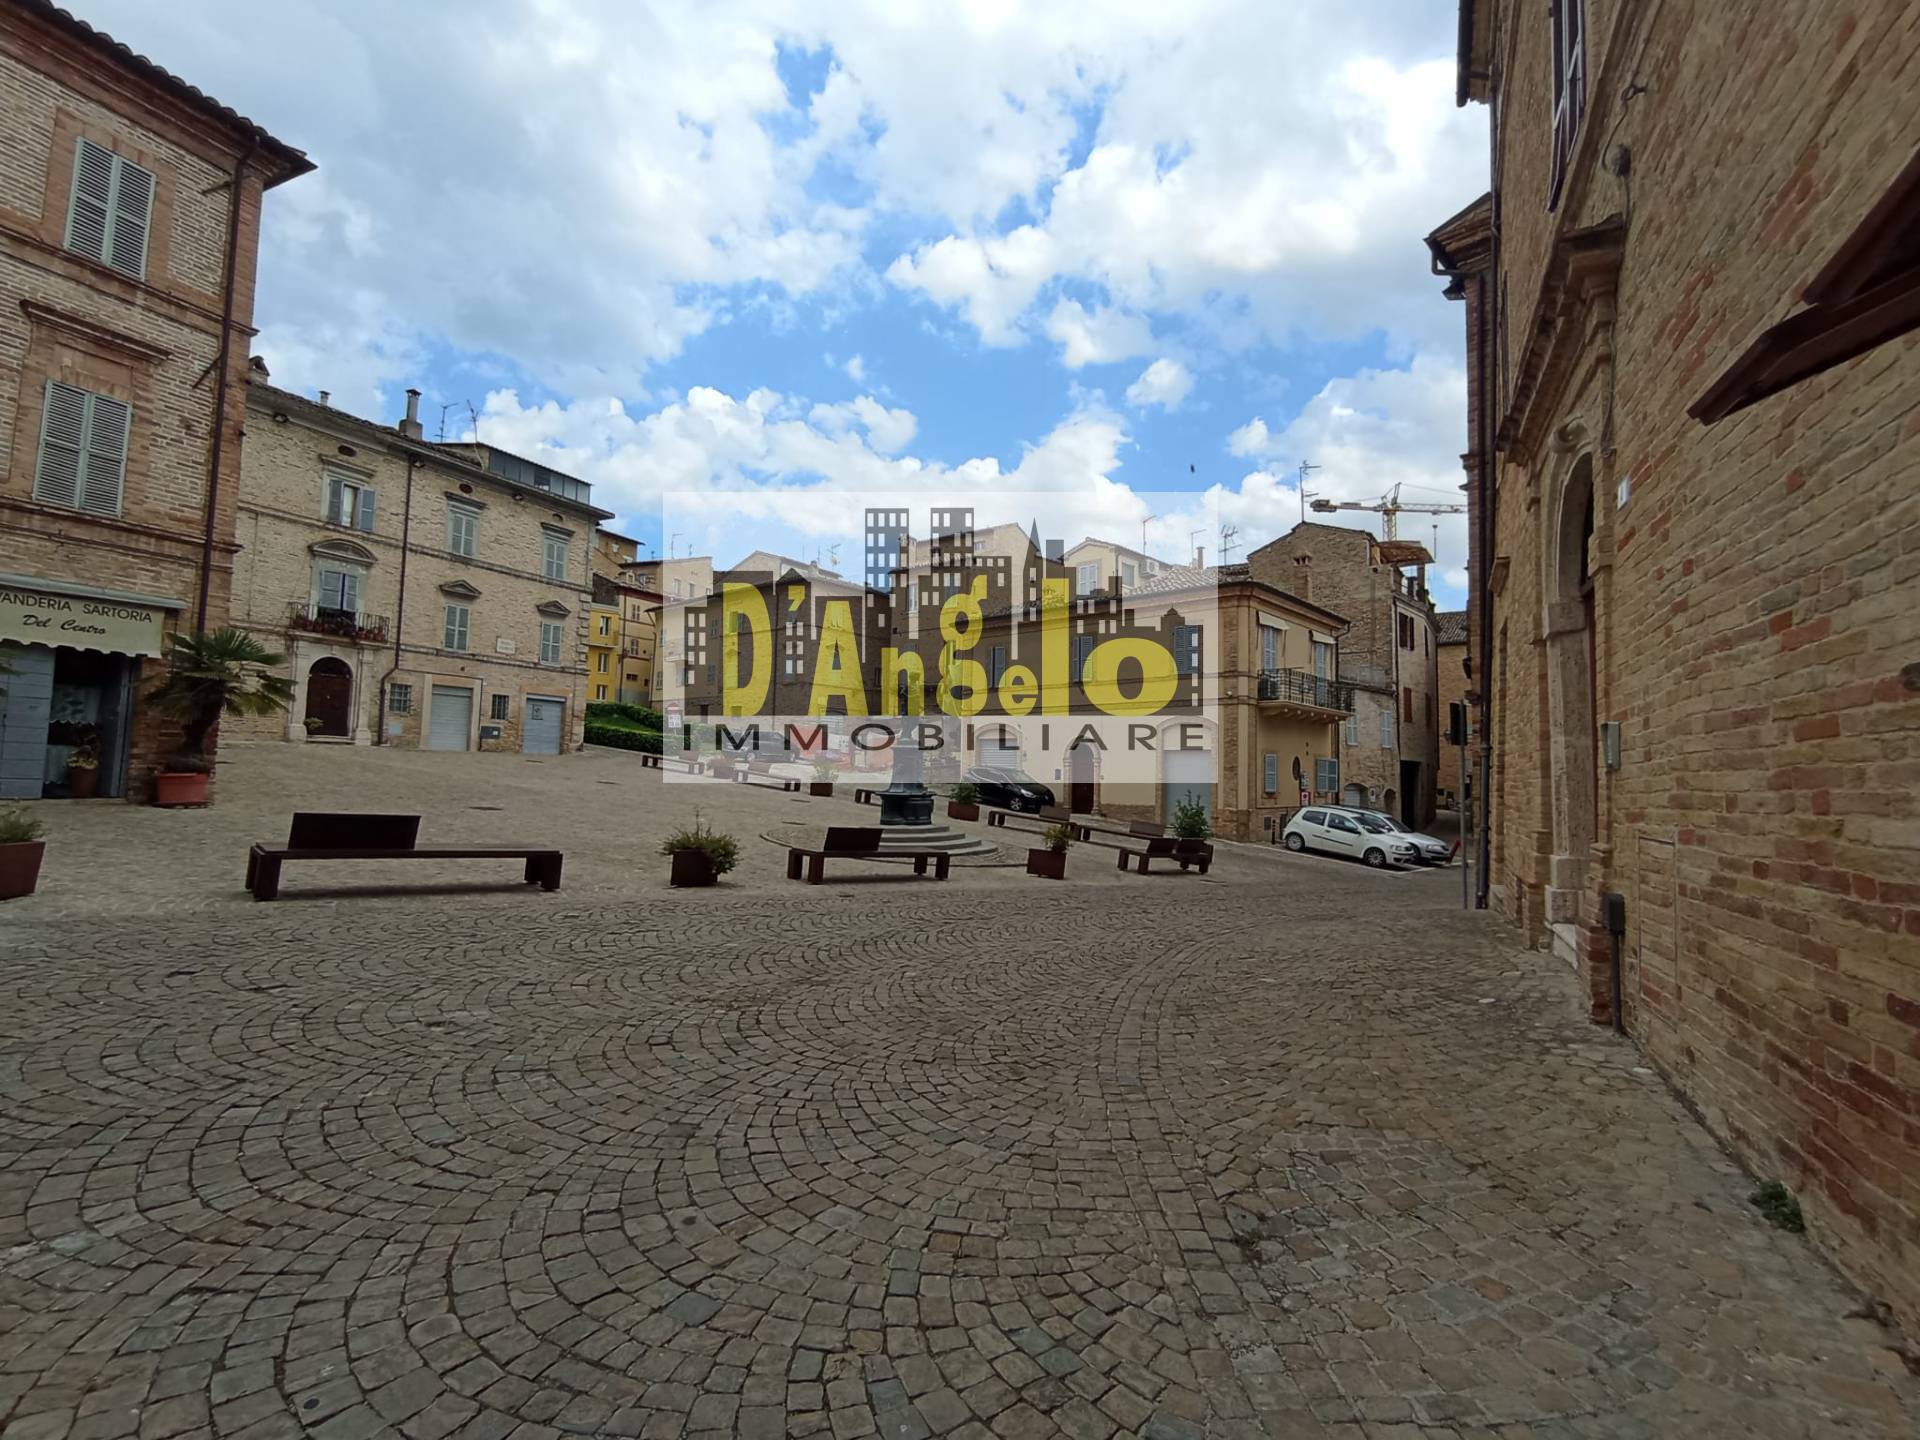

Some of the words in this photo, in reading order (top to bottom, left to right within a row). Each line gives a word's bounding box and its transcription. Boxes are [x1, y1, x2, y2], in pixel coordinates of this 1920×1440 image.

[0, 592, 72, 612] ANDERIA
[82, 603, 152, 623] SARTORIA
[23, 614, 52, 628] Del
[60, 619, 106, 634] Centro
